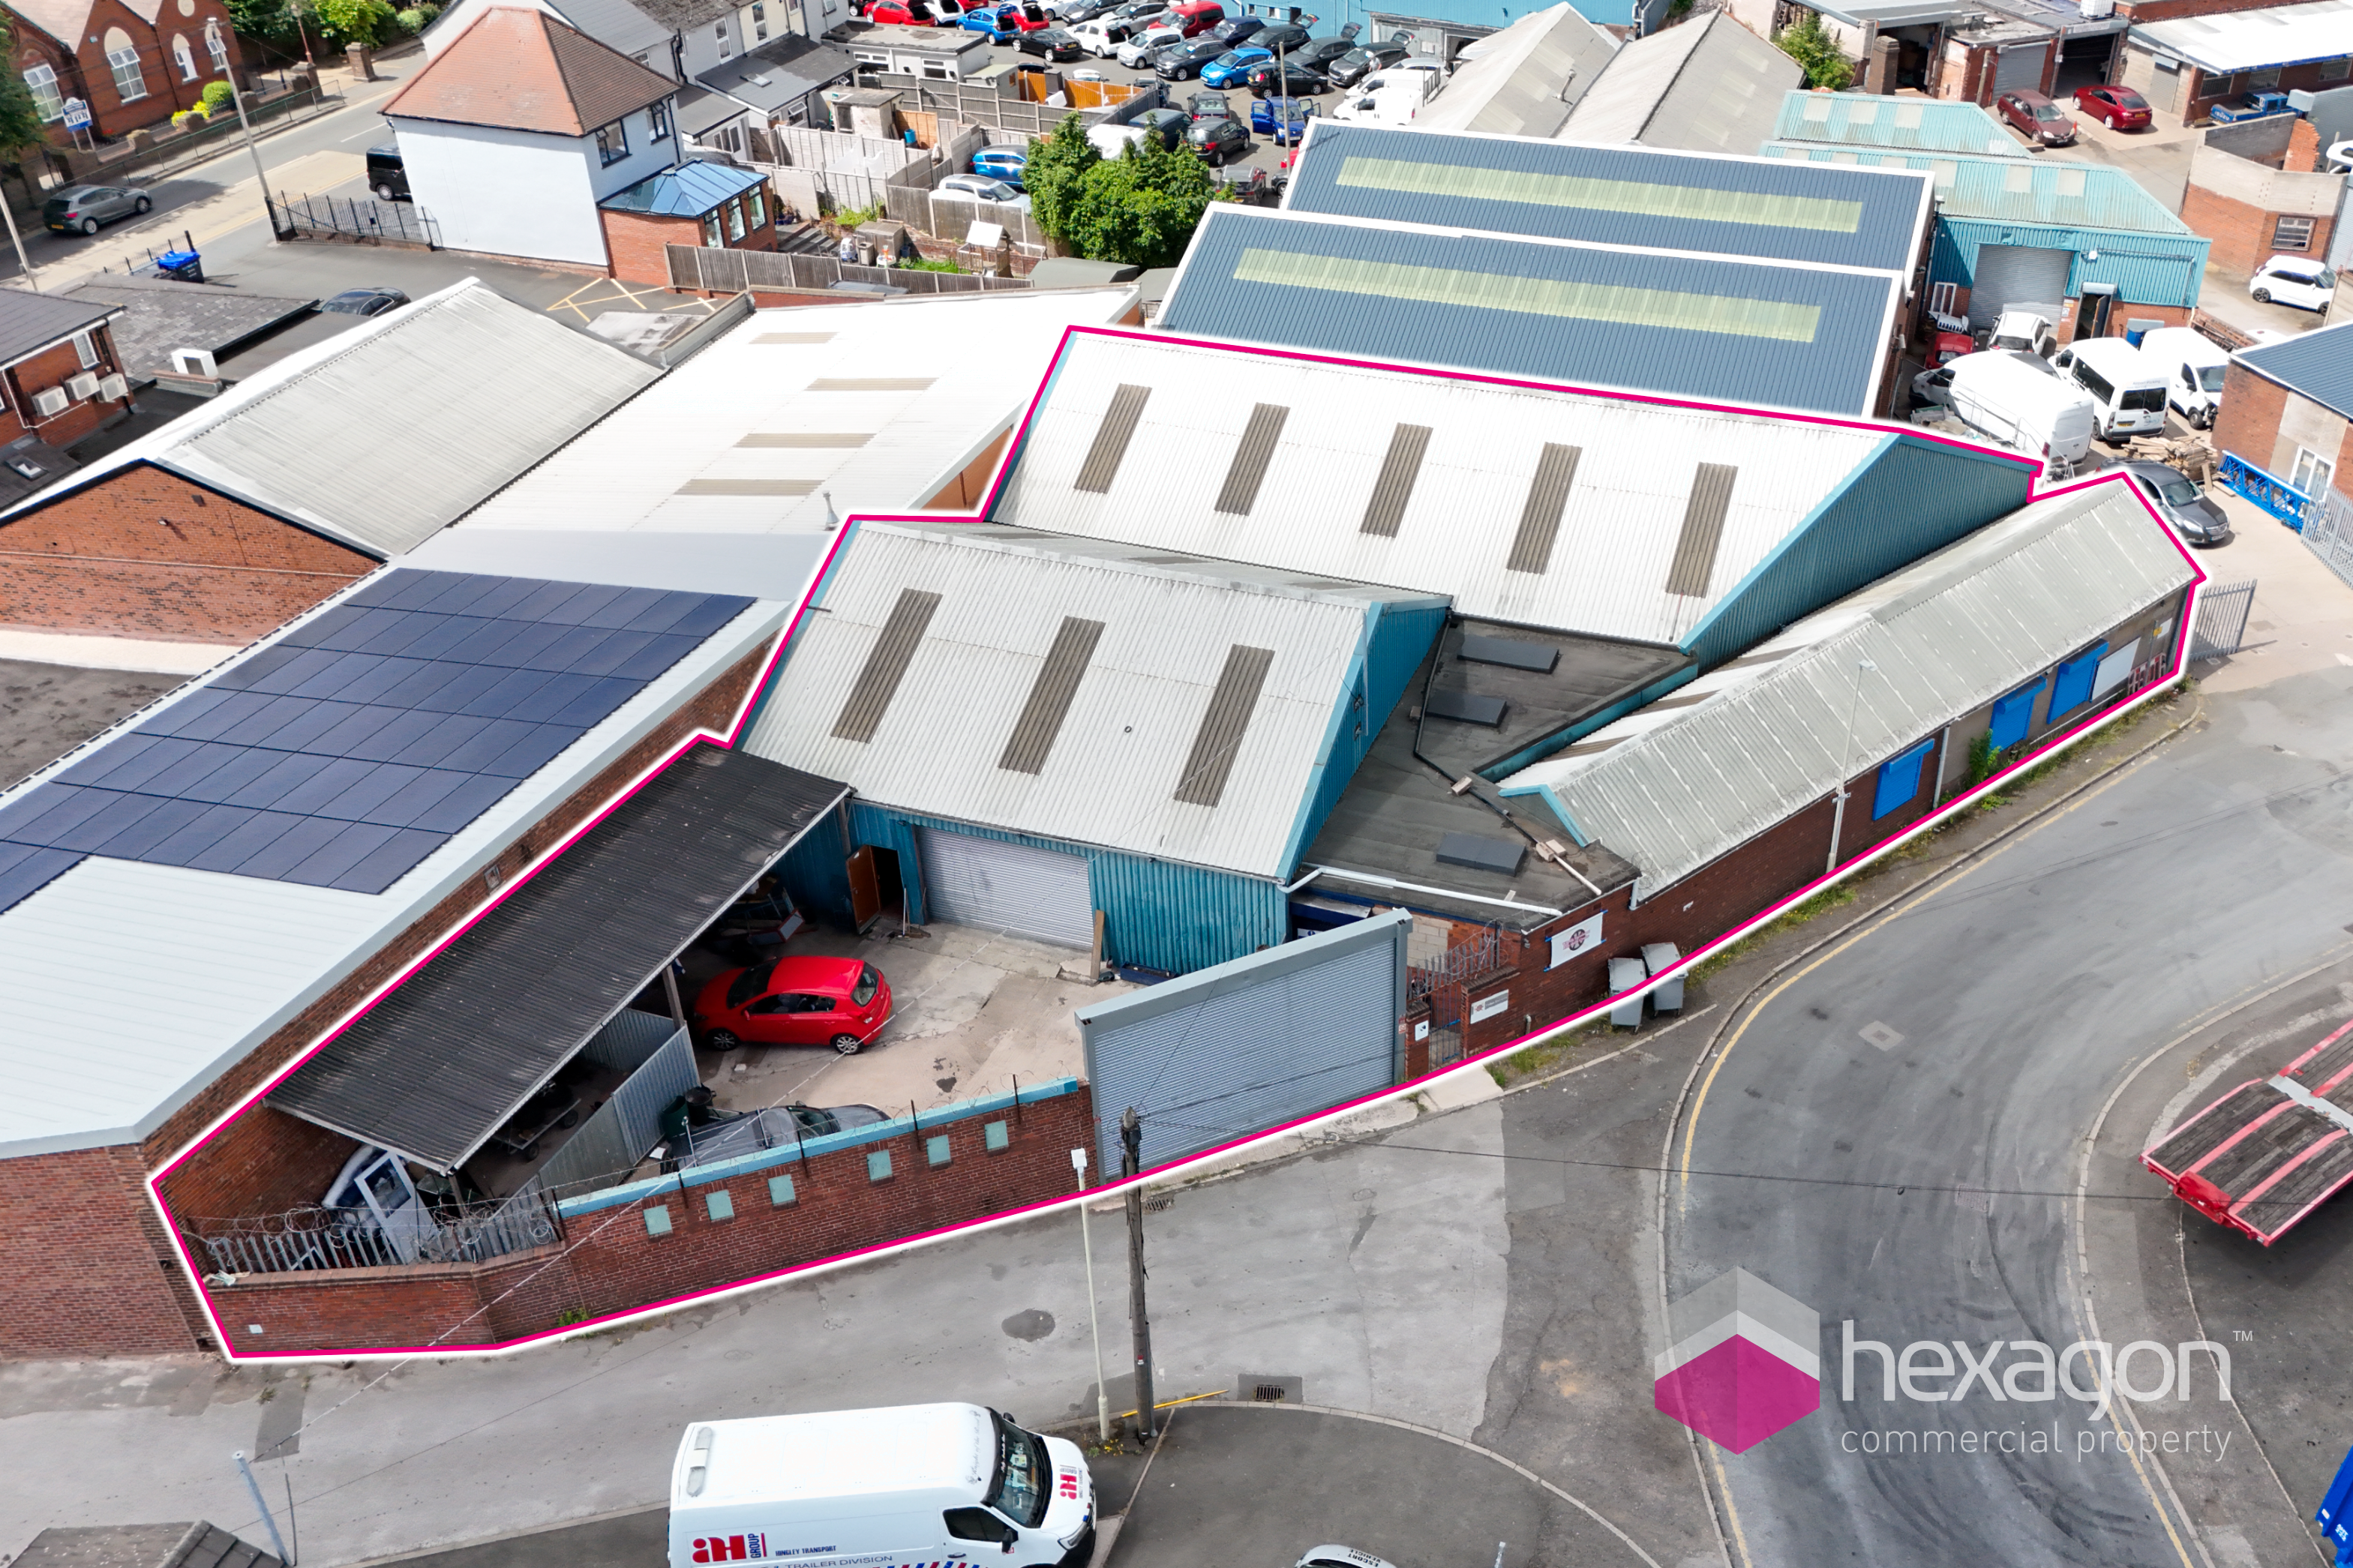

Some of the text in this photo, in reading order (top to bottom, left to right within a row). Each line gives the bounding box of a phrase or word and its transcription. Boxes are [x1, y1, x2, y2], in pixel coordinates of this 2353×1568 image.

[748, 1533, 762, 1559] GROUP
[775, 1545, 836, 1557] HINGLEY TRANSPORT
[785, 1560, 836, 1568] TRAILER
[839, 1555, 893, 1566] DIVISION
[1347, 1553, 1379, 1567] ESCORT
[1350, 1549, 1381, 1563] VEHICLE
